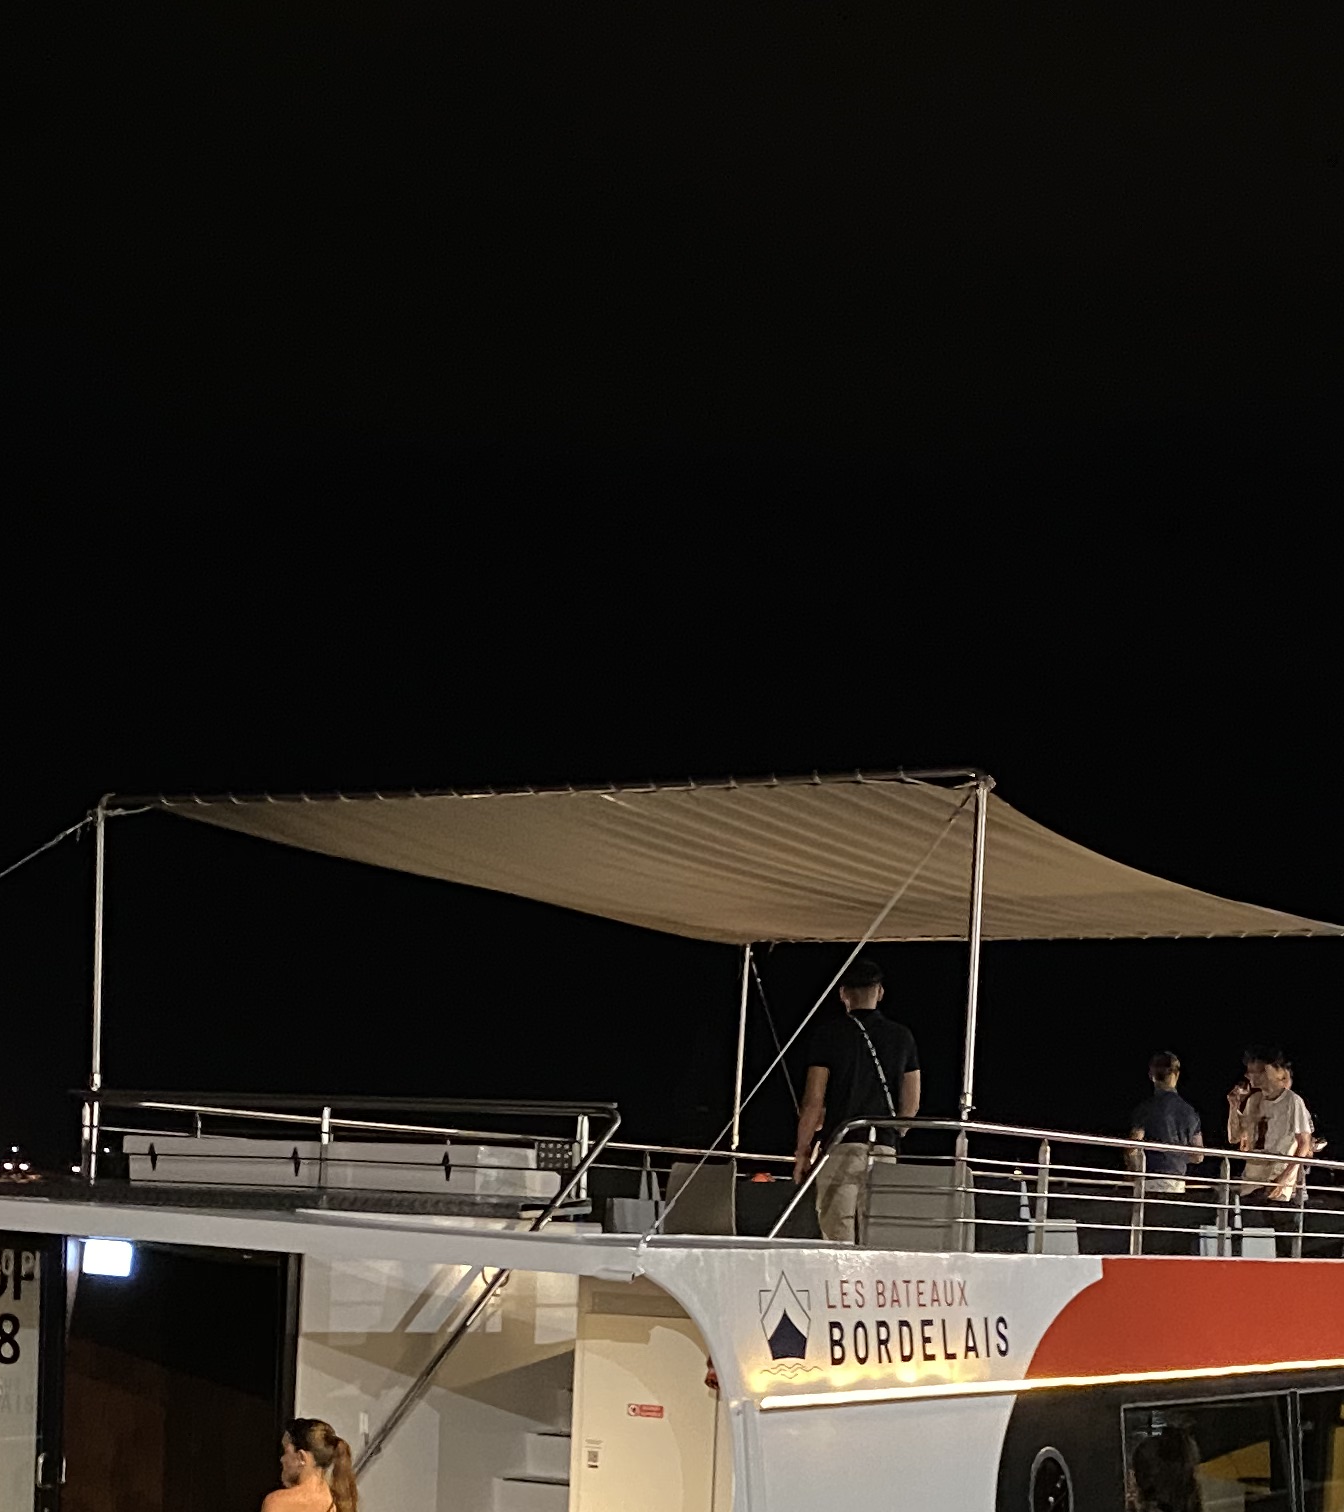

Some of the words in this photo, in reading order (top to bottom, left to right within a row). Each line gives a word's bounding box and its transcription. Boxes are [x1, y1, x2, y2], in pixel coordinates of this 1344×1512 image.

[825, 1279, 866, 1309] LES
[875, 1278, 970, 1309] BATEAUX
[828, 1315, 1011, 1367] BORDELAIS
